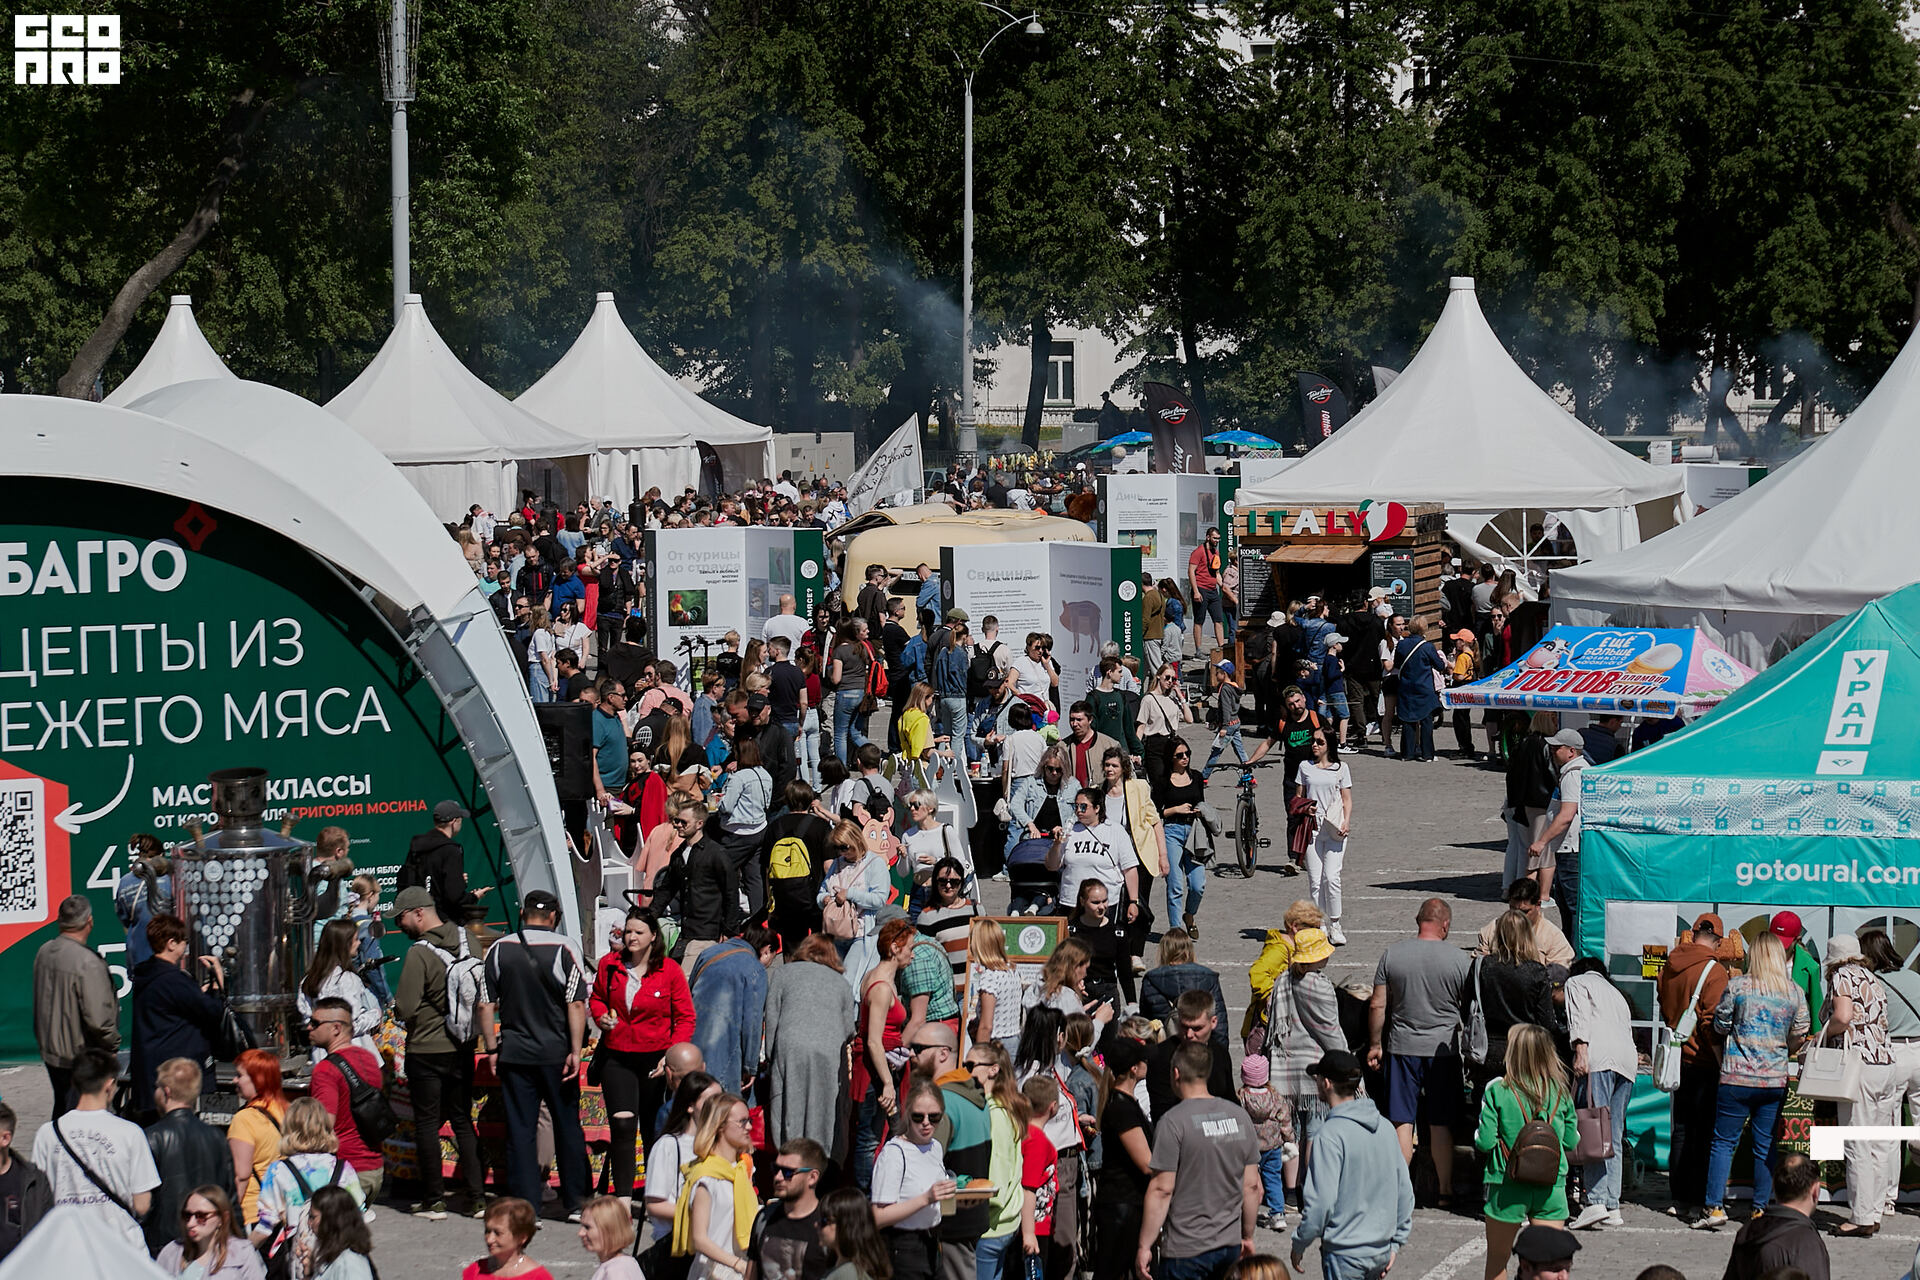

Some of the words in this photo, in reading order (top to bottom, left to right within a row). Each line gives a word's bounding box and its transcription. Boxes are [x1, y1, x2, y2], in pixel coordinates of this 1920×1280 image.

[1248, 509, 1370, 535] ITALY
[0, 538, 188, 597] БАГРО
[667, 564, 683, 574] до
[687, 563, 741, 574] страуса
[668, 551, 684, 561] От
[687, 551, 740, 564] курицы
[967, 569, 1032, 581] Свинина
[1124, 611, 1132, 643] МЯСЕ?
[230, 617, 304, 669] ИЗ
[1584, 647, 1635, 656] БОЛЬШЕ
[1599, 636, 1638, 648] ЕЩЁ
[1836, 657, 1876, 738] УРАЛ
[1, 694, 203, 752] ЕЖЕГО
[224, 686, 391, 741] МЯСА
[1290, 729, 1310, 740] NIKE
[152, 783, 212, 808] МАС
[154, 814, 175, 828] ОТ
[291, 801, 364, 819] ГРИГОРИЯ
[367, 799, 427, 815] МОСИНА
[376, 864, 402, 875] ЯБЛО
[1735, 858, 1920, 887] gotoural.com
